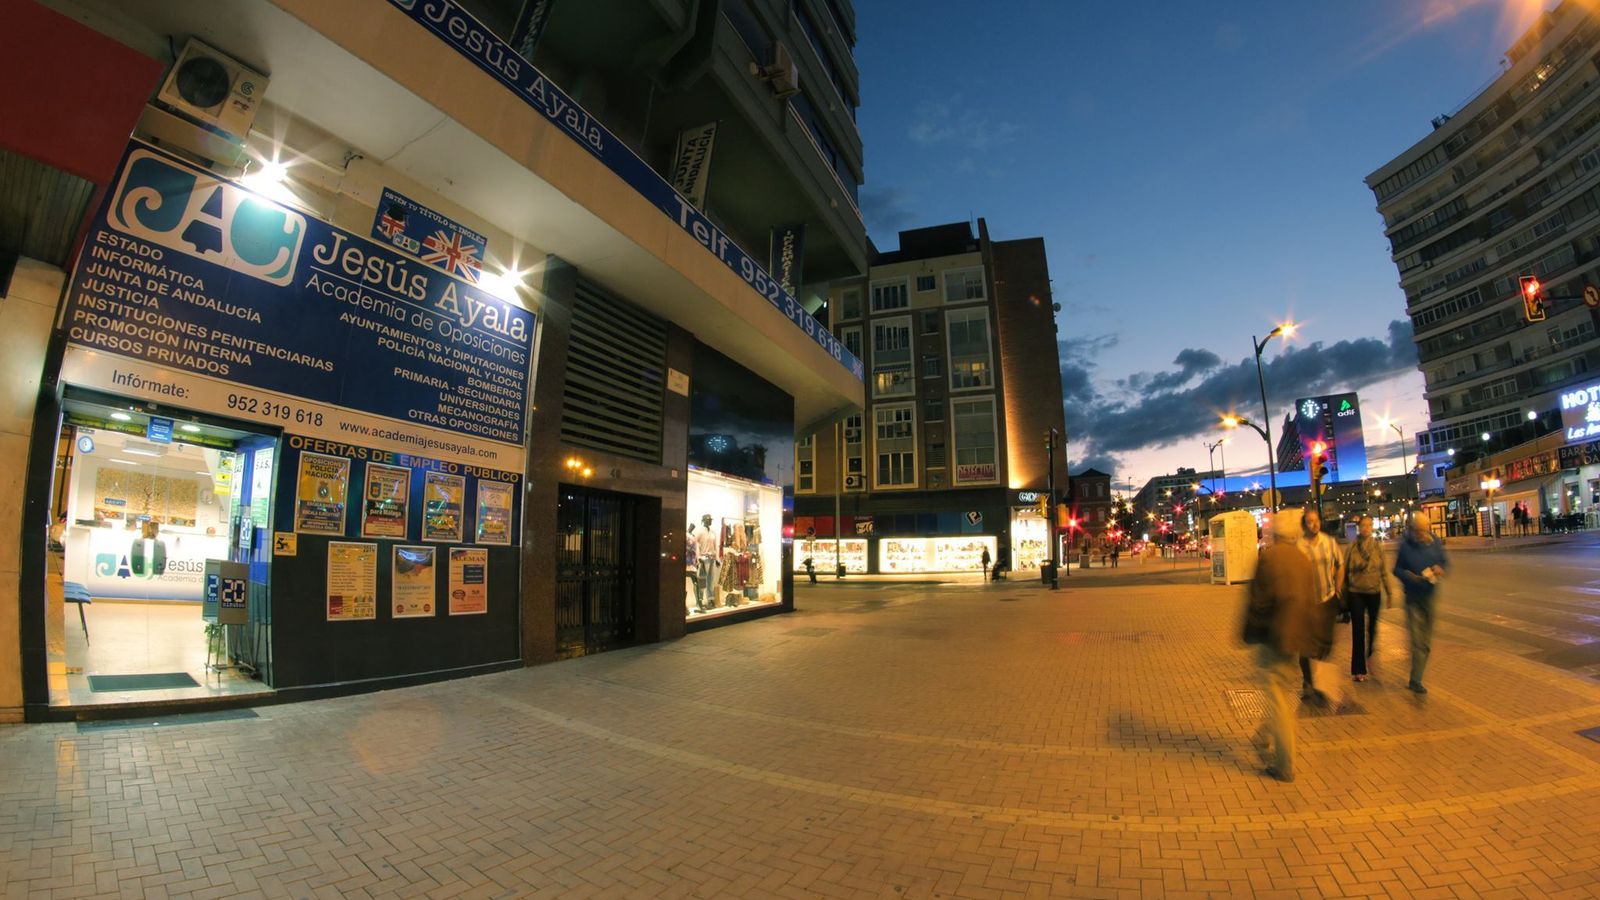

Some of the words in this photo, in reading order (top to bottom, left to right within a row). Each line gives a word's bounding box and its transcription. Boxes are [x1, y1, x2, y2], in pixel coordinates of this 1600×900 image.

[424, 0, 520, 80] Jesús
[526, 77, 603, 150] Ayala
[96, 231, 163, 261] ESTADO
[92, 246, 205, 291] INFORMÁTICA
[313, 232, 428, 301] Jesús
[434, 281, 528, 343] Ayala
[674, 194, 734, 267] Telf.
[741, 256, 779, 307] 952
[784, 297, 814, 336] 319
[818, 328, 842, 361] 618
[82, 278, 160, 310] JUSTICIA
[87, 262, 142, 291] JUNTA
[147, 279, 168, 296] DE
[172, 287, 262, 324] ANDALUCÍA
[73, 310, 179, 347] PROMOCIÓN
[184, 338, 253, 367] INTERNA
[77, 293, 207, 338] INSTITUCIONES
[211, 331, 335, 372] PENITENCIARIAS
[305, 273, 407, 322] Academia
[411, 311, 433, 330] de
[438, 320, 525, 365] Oposiciones
[70, 326, 142, 354] CURSOS
[147, 346, 230, 376] PRIVADOS
[340, 312, 442, 352] AYUNTAMIENTOS
[444, 346, 452, 355] Y
[453, 349, 524, 380] DIPUTACIONES
[377, 336, 425, 360] POLICÍA
[428, 353, 483, 378] NACIONAL
[485, 371, 493, 380] Y
[493, 374, 523, 390] LOCAL
[112, 369, 190, 399] Infórmate:
[394, 367, 449, 390] PRIMARIA
[457, 386, 521, 410] SECUNDARIA
[440, 392, 520, 420] UNIVERSIDADES
[467, 377, 522, 400] BOMBEROS
[1562, 385, 1600, 409] HOT
[227, 394, 257, 413] 952
[261, 401, 291, 420] 319
[295, 408, 323, 427] 618
[408, 409, 447, 426] OTRAS
[449, 417, 518, 442] OPOSICIONES
[438, 404, 519, 431] MECANOGRAFÍA
[289, 436, 368, 461] OFERTAS
[371, 452, 393, 463] DE
[399, 454, 458, 474] EMPLEO
[464, 465, 520, 483] PUBLICO
[340, 420, 497, 460] www.academiajesusayala.com
[222, 579, 245, 602] 20
